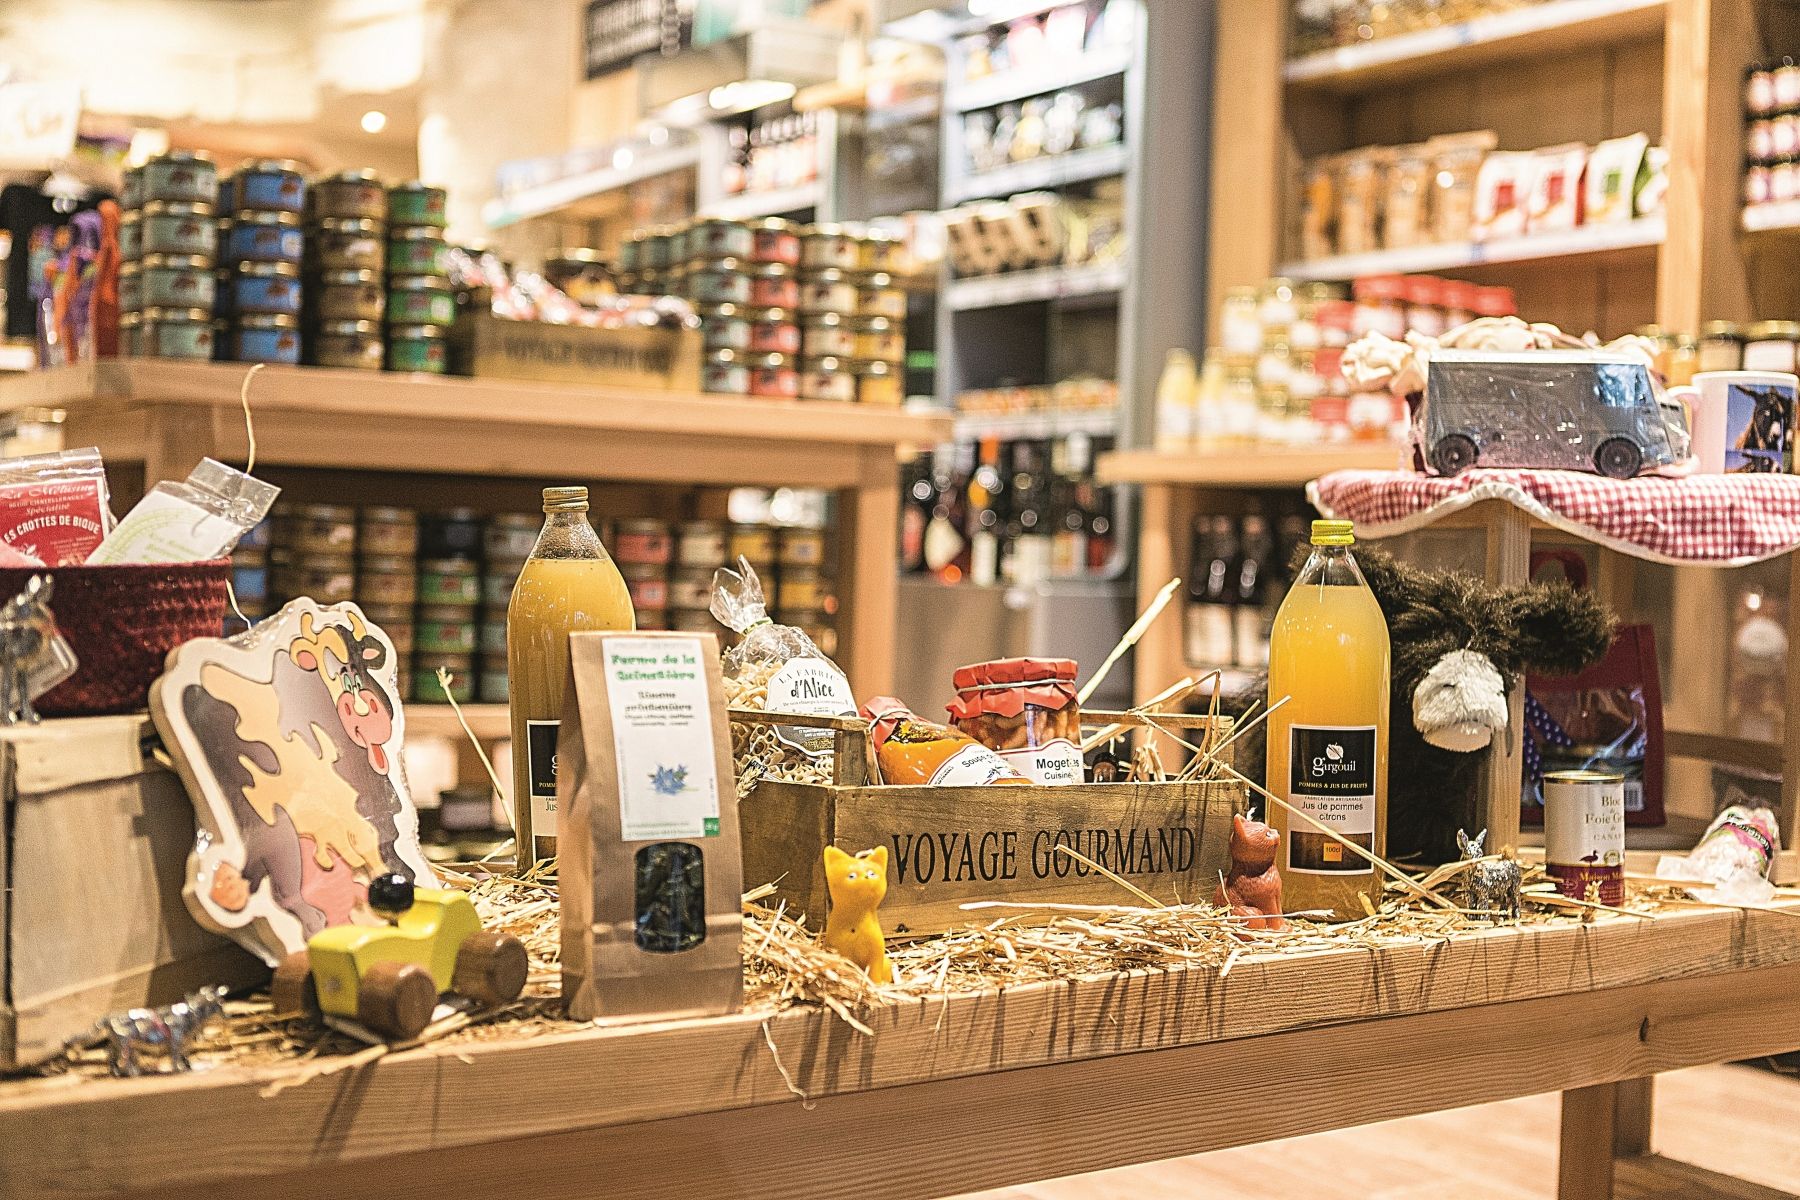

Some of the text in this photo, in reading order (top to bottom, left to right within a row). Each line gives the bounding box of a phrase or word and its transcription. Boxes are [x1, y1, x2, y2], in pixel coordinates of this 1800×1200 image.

[4, 515, 101, 544] ES CROTTES DE BIQUE
[791, 677, 834, 698] d'Alice
[1312, 757, 1356, 776] gargouil
[1301, 801, 1364, 812] Jus de pommes
[1319, 813, 1346, 821] citrons
[891, 827, 1196, 884] VOYAGE GOURMAND
